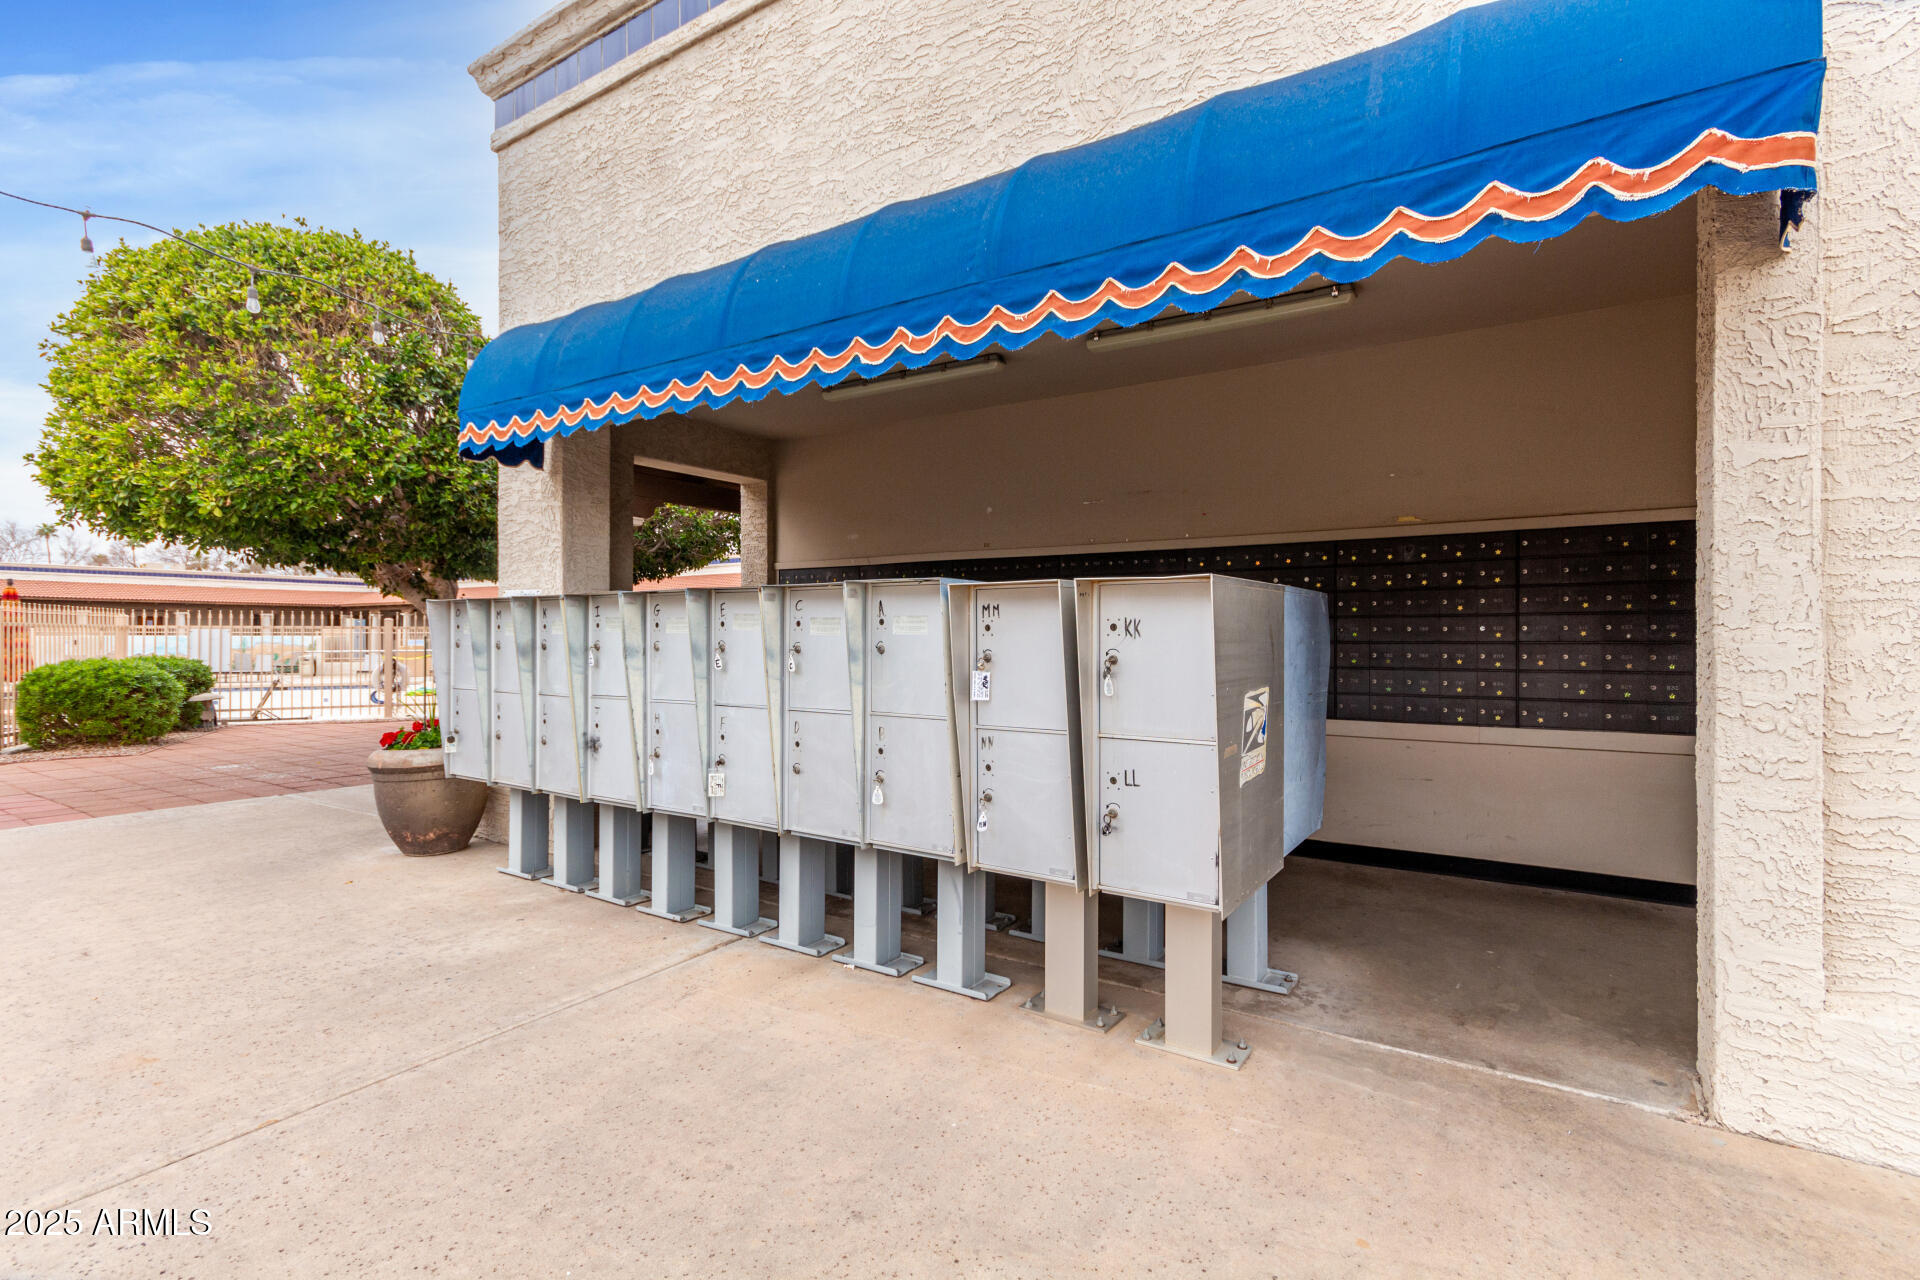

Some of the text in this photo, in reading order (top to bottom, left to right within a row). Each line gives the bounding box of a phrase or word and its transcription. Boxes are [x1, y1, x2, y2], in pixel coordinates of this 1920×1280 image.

[654, 603, 661, 616] G
[720, 602, 726, 617] E
[795, 599, 803, 611] C
[879, 599, 885, 617] A
[1124, 616, 1142, 639] KK
[715, 659, 721, 668] E
[720, 716, 727, 730] F
[1124, 769, 1141, 787] LL
